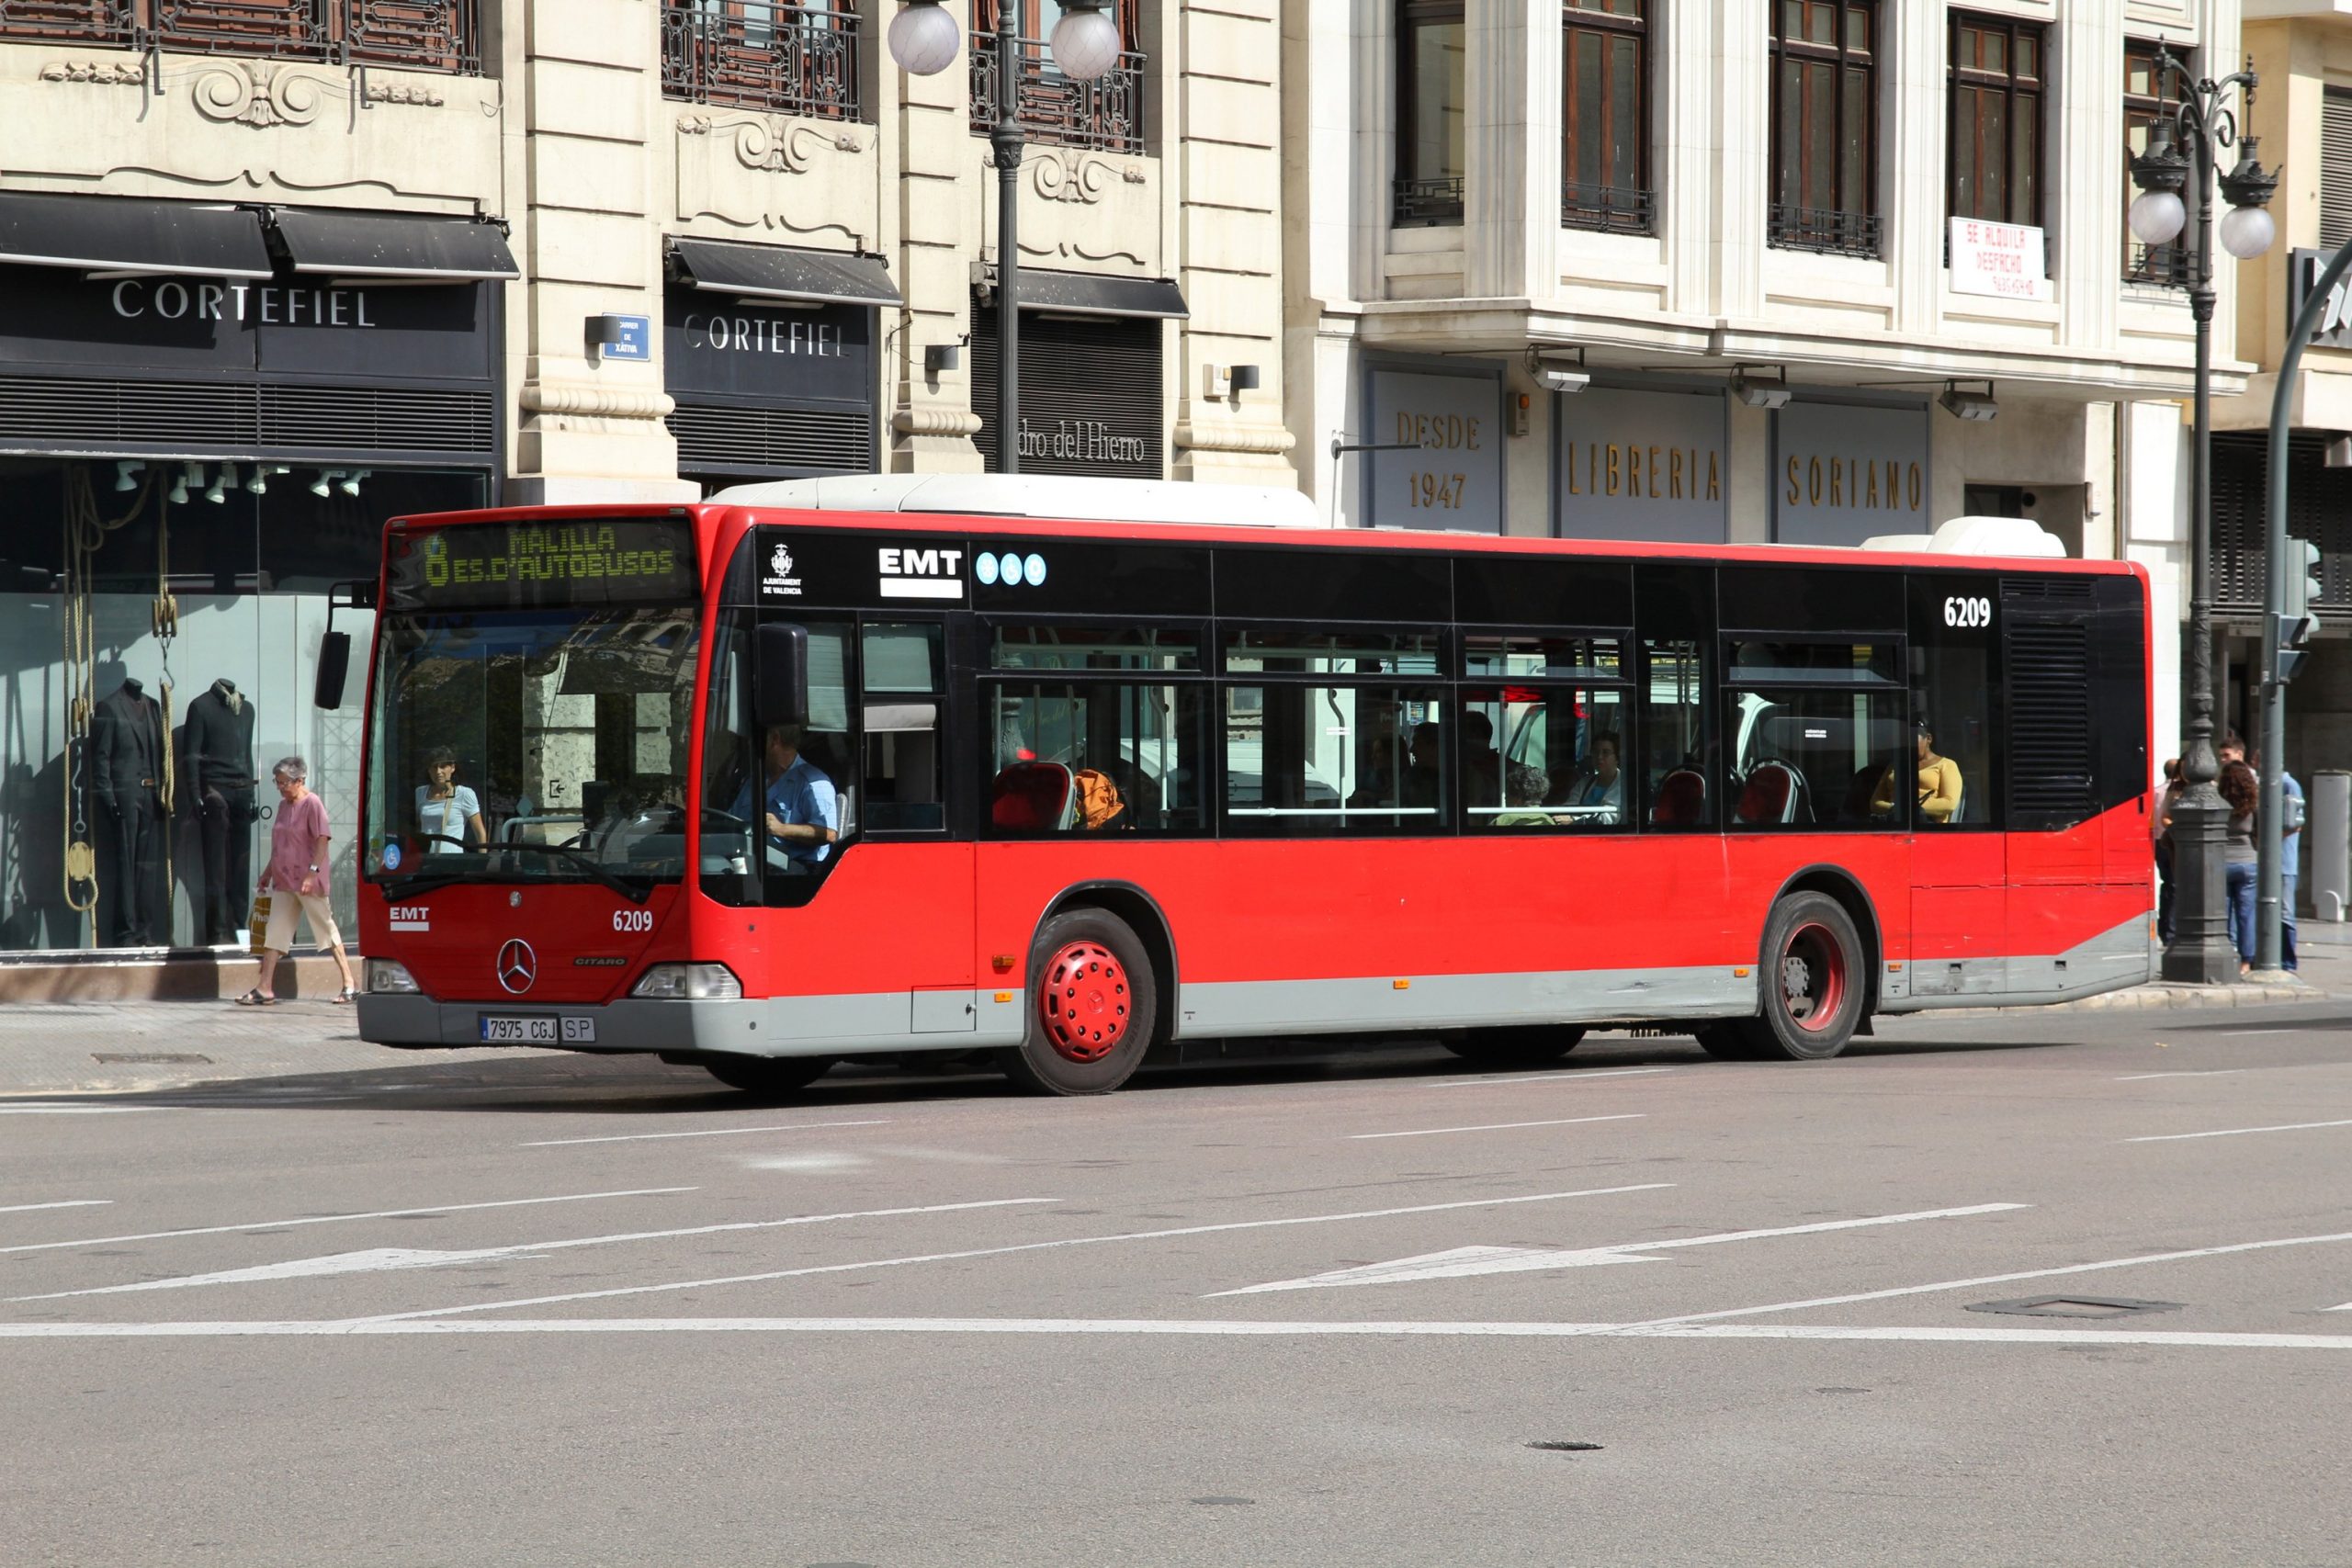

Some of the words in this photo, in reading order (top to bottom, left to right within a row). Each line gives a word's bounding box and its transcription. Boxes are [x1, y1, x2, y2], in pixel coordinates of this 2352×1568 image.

[1967, 223, 1978, 243] SE
[112, 279, 376, 326] CORTEFIEL
[684, 314, 850, 357] CORTEFIEL
[1017, 419, 1047, 457] dro
[1086, 422, 1145, 461] Hierro
[1396, 411, 1481, 450] DESDE
[1569, 441, 1720, 502] LIBRERIA
[1786, 456, 1921, 511] SORIANO
[1409, 471, 1466, 509] 1947
[509, 527, 616, 554] MALILLA
[878, 548, 963, 576] EMT
[763, 578, 802, 586] AJUNTAMENT
[763, 586, 773, 594] DE
[773, 587, 802, 595] VALENCIA
[1944, 597, 1991, 627] 6209
[390, 907, 429, 919] EMT
[613, 910, 653, 931] 6209
[491, 1021, 523, 1039] 7975
[531, 1021, 556, 1039] CGJ
[565, 1020, 590, 1038] SP
